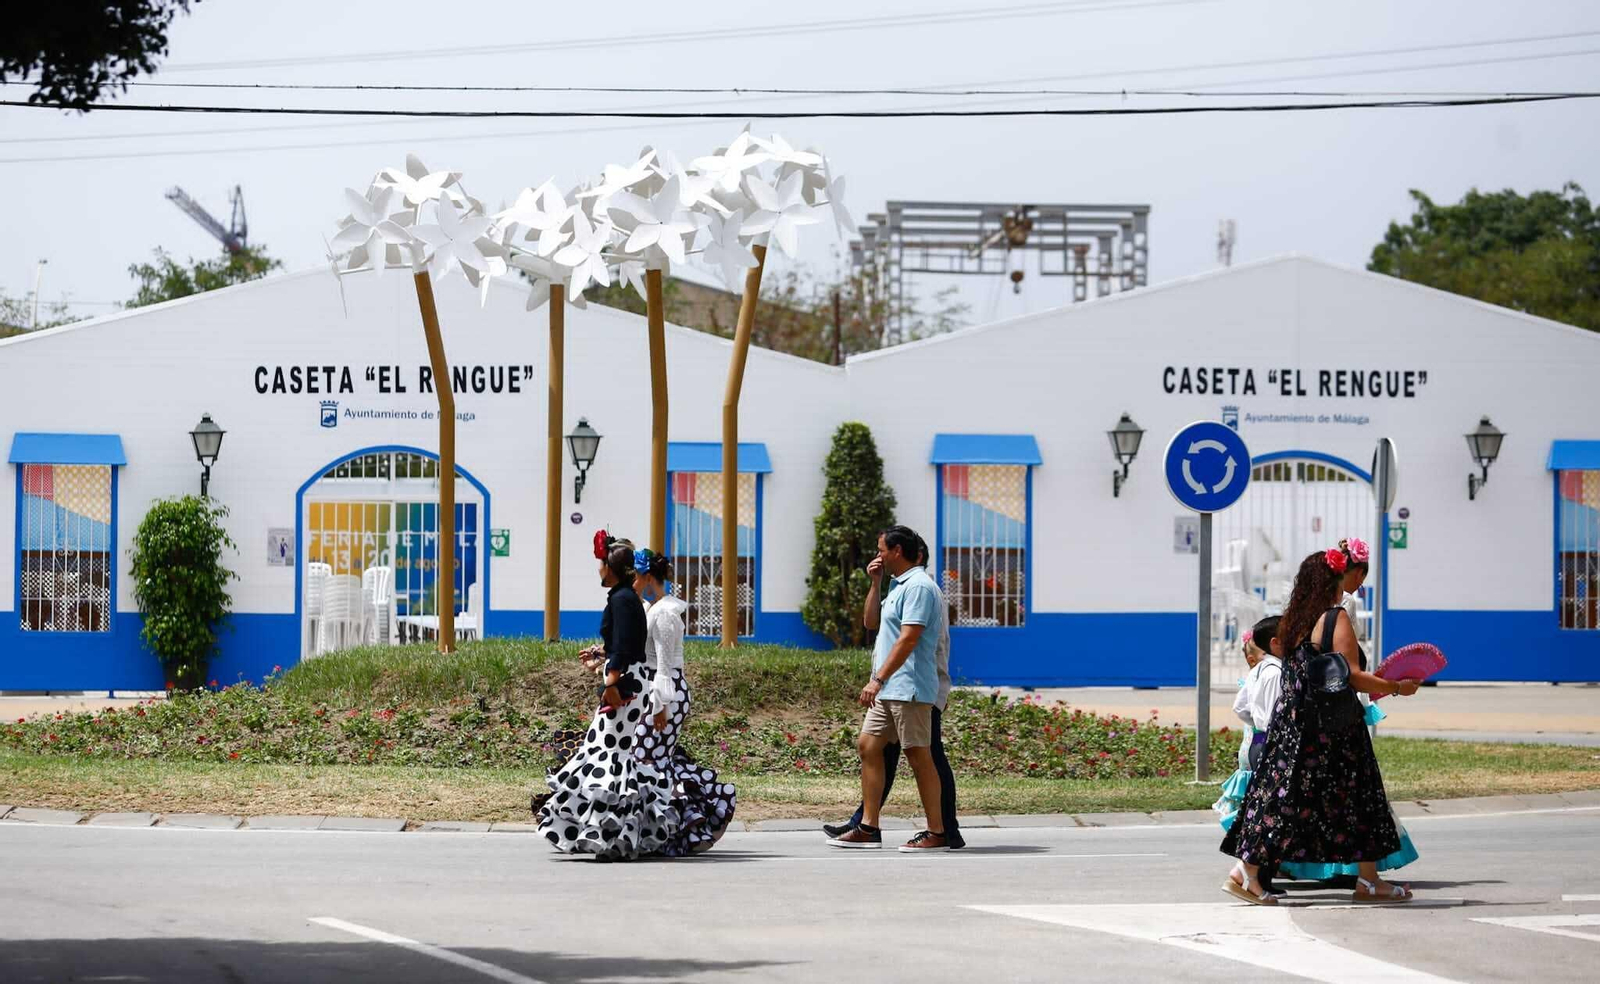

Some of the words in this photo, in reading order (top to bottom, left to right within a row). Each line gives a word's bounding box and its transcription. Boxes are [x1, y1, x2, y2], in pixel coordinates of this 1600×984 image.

[255, 366, 354, 394] CASETA
[419, 365, 534, 394] RNGUE”
[1163, 366, 1257, 396] CASETA
[343, 407, 418, 421] Ayuntamiento
[421, 410, 434, 420] de
[1244, 412, 1315, 424] Ayuntamiento
[1318, 414, 1330, 424] de
[1333, 413, 1370, 425] Málaga
[309, 530, 376, 547] FERIA
[368, 549, 392, 568] 20
[415, 558, 461, 572] agoo
